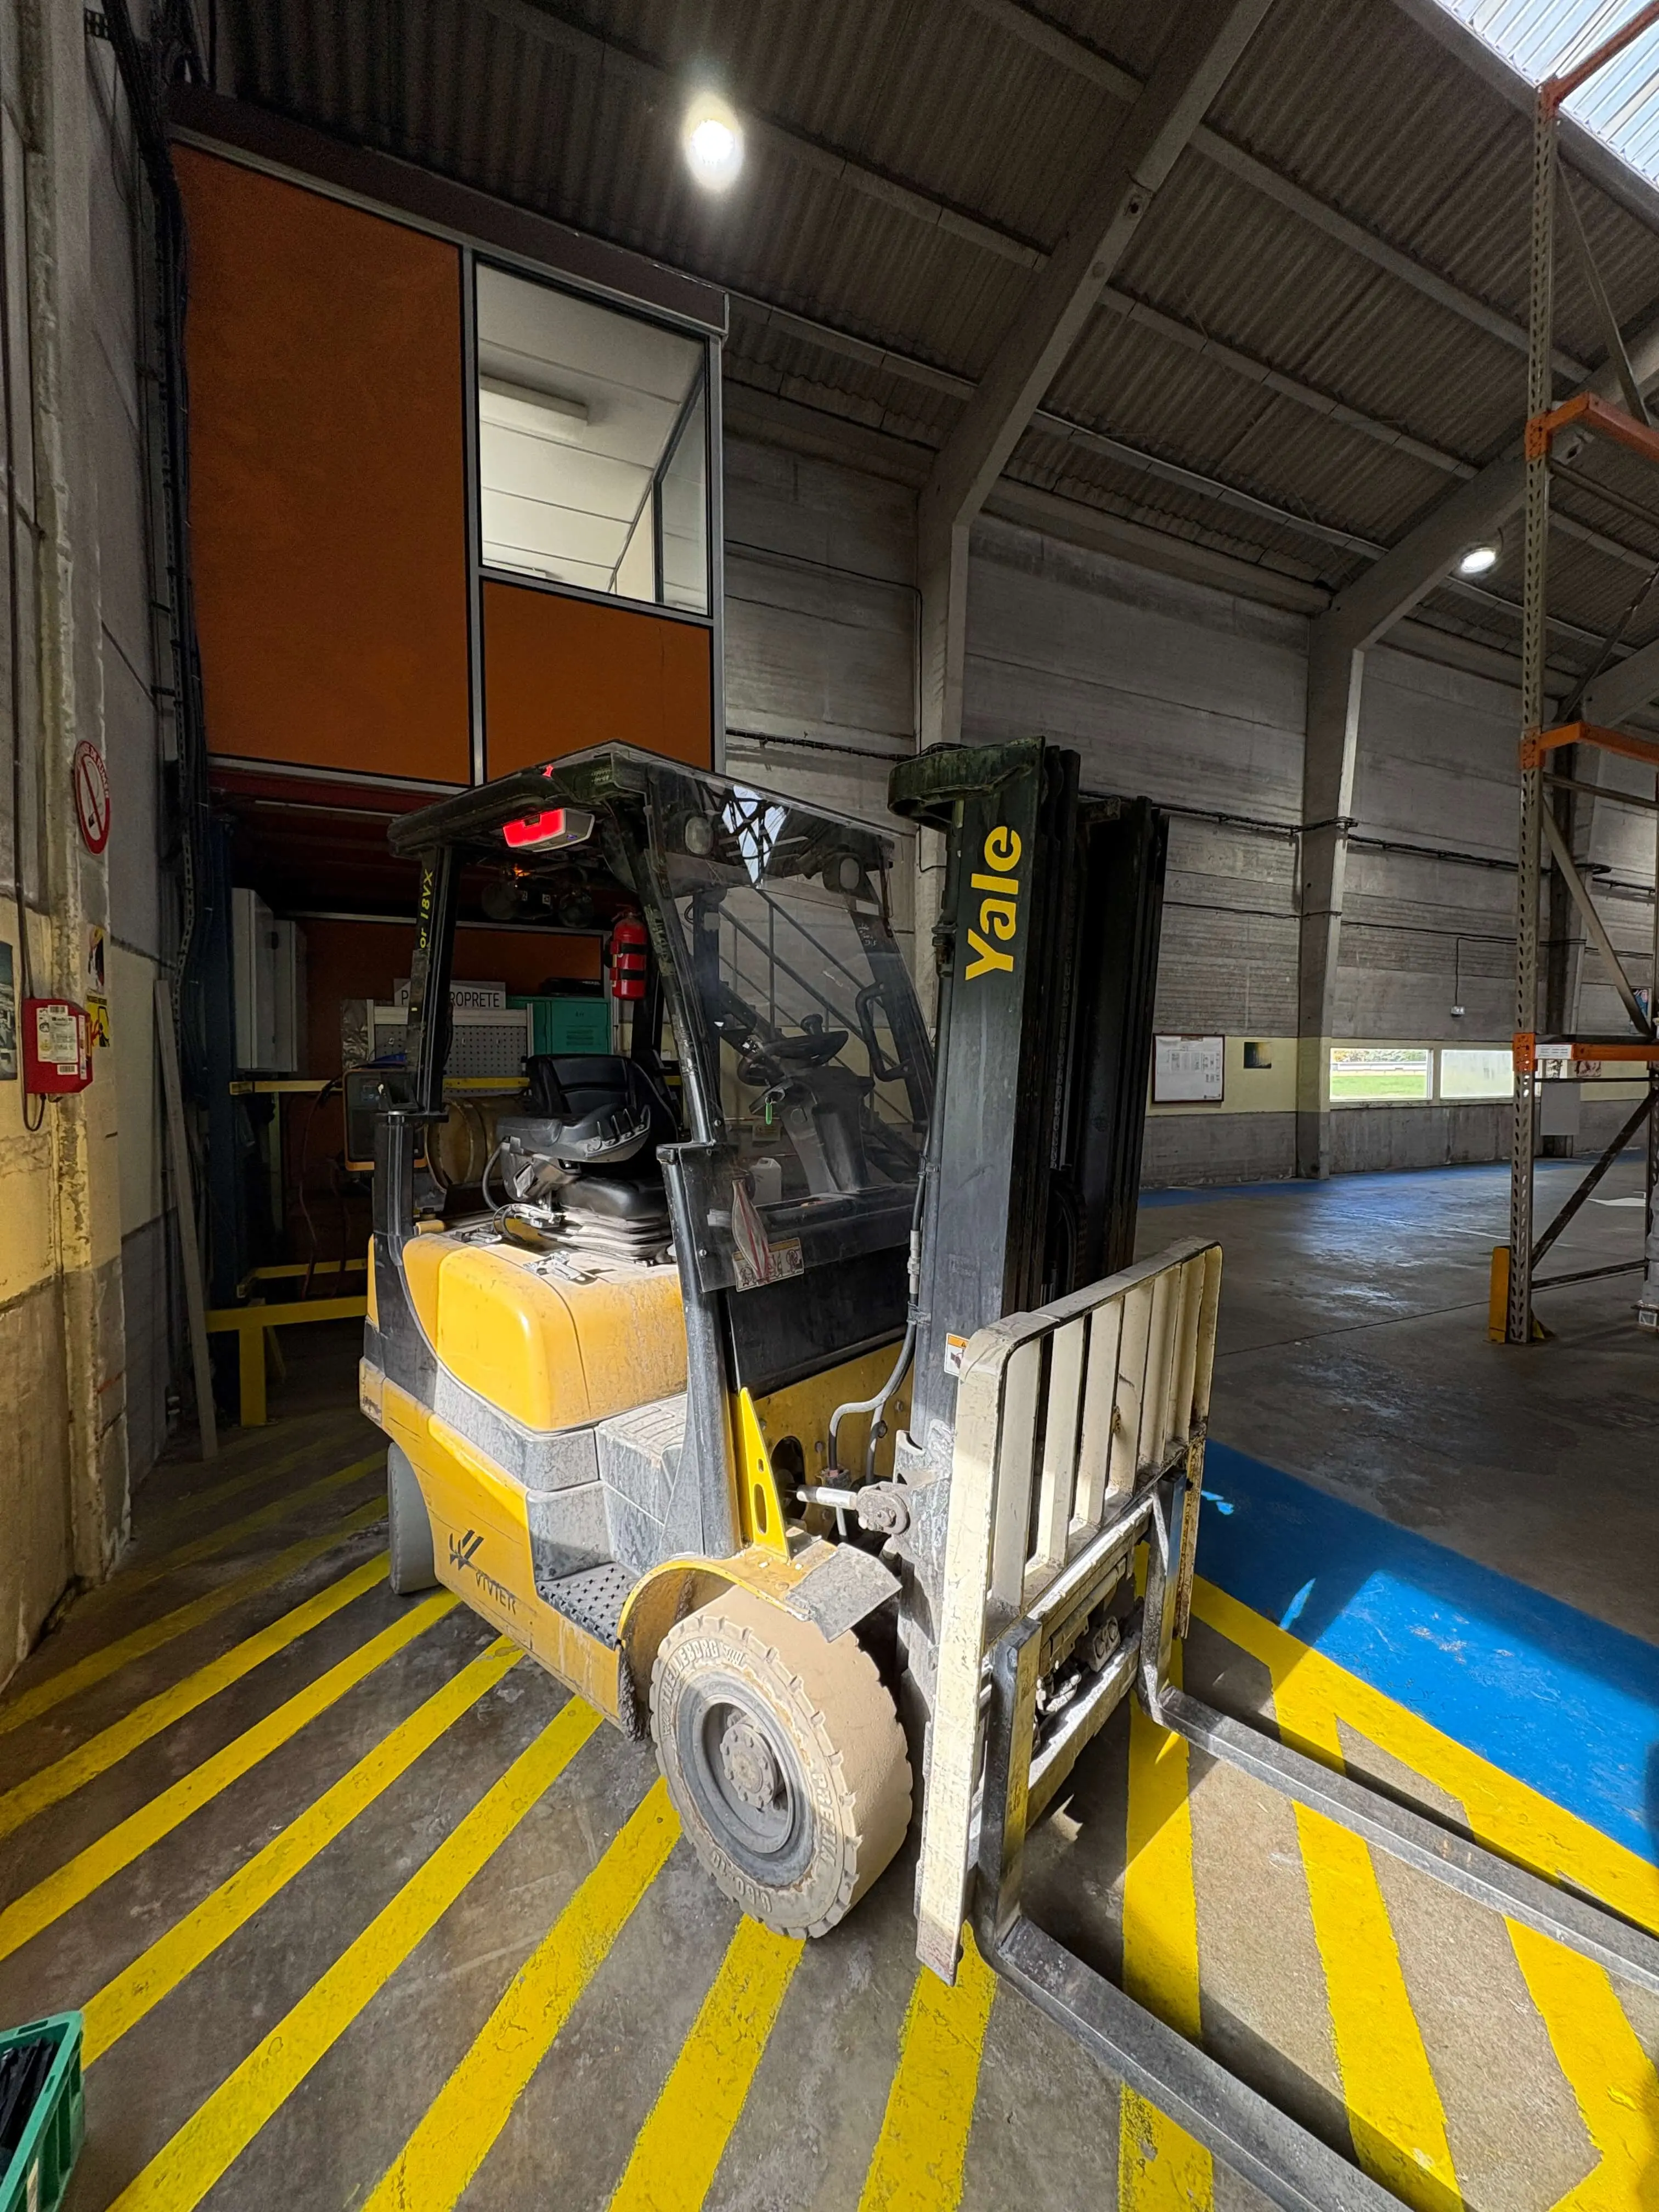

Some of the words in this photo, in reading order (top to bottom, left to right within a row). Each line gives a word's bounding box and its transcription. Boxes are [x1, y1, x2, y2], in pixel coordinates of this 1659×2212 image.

[421, 868, 433, 919] 18VX
[966, 826, 1021, 980] Yale
[450, 991, 500, 1007] ROPRETE
[663, 1639, 719, 1705] TRELLEBORG
